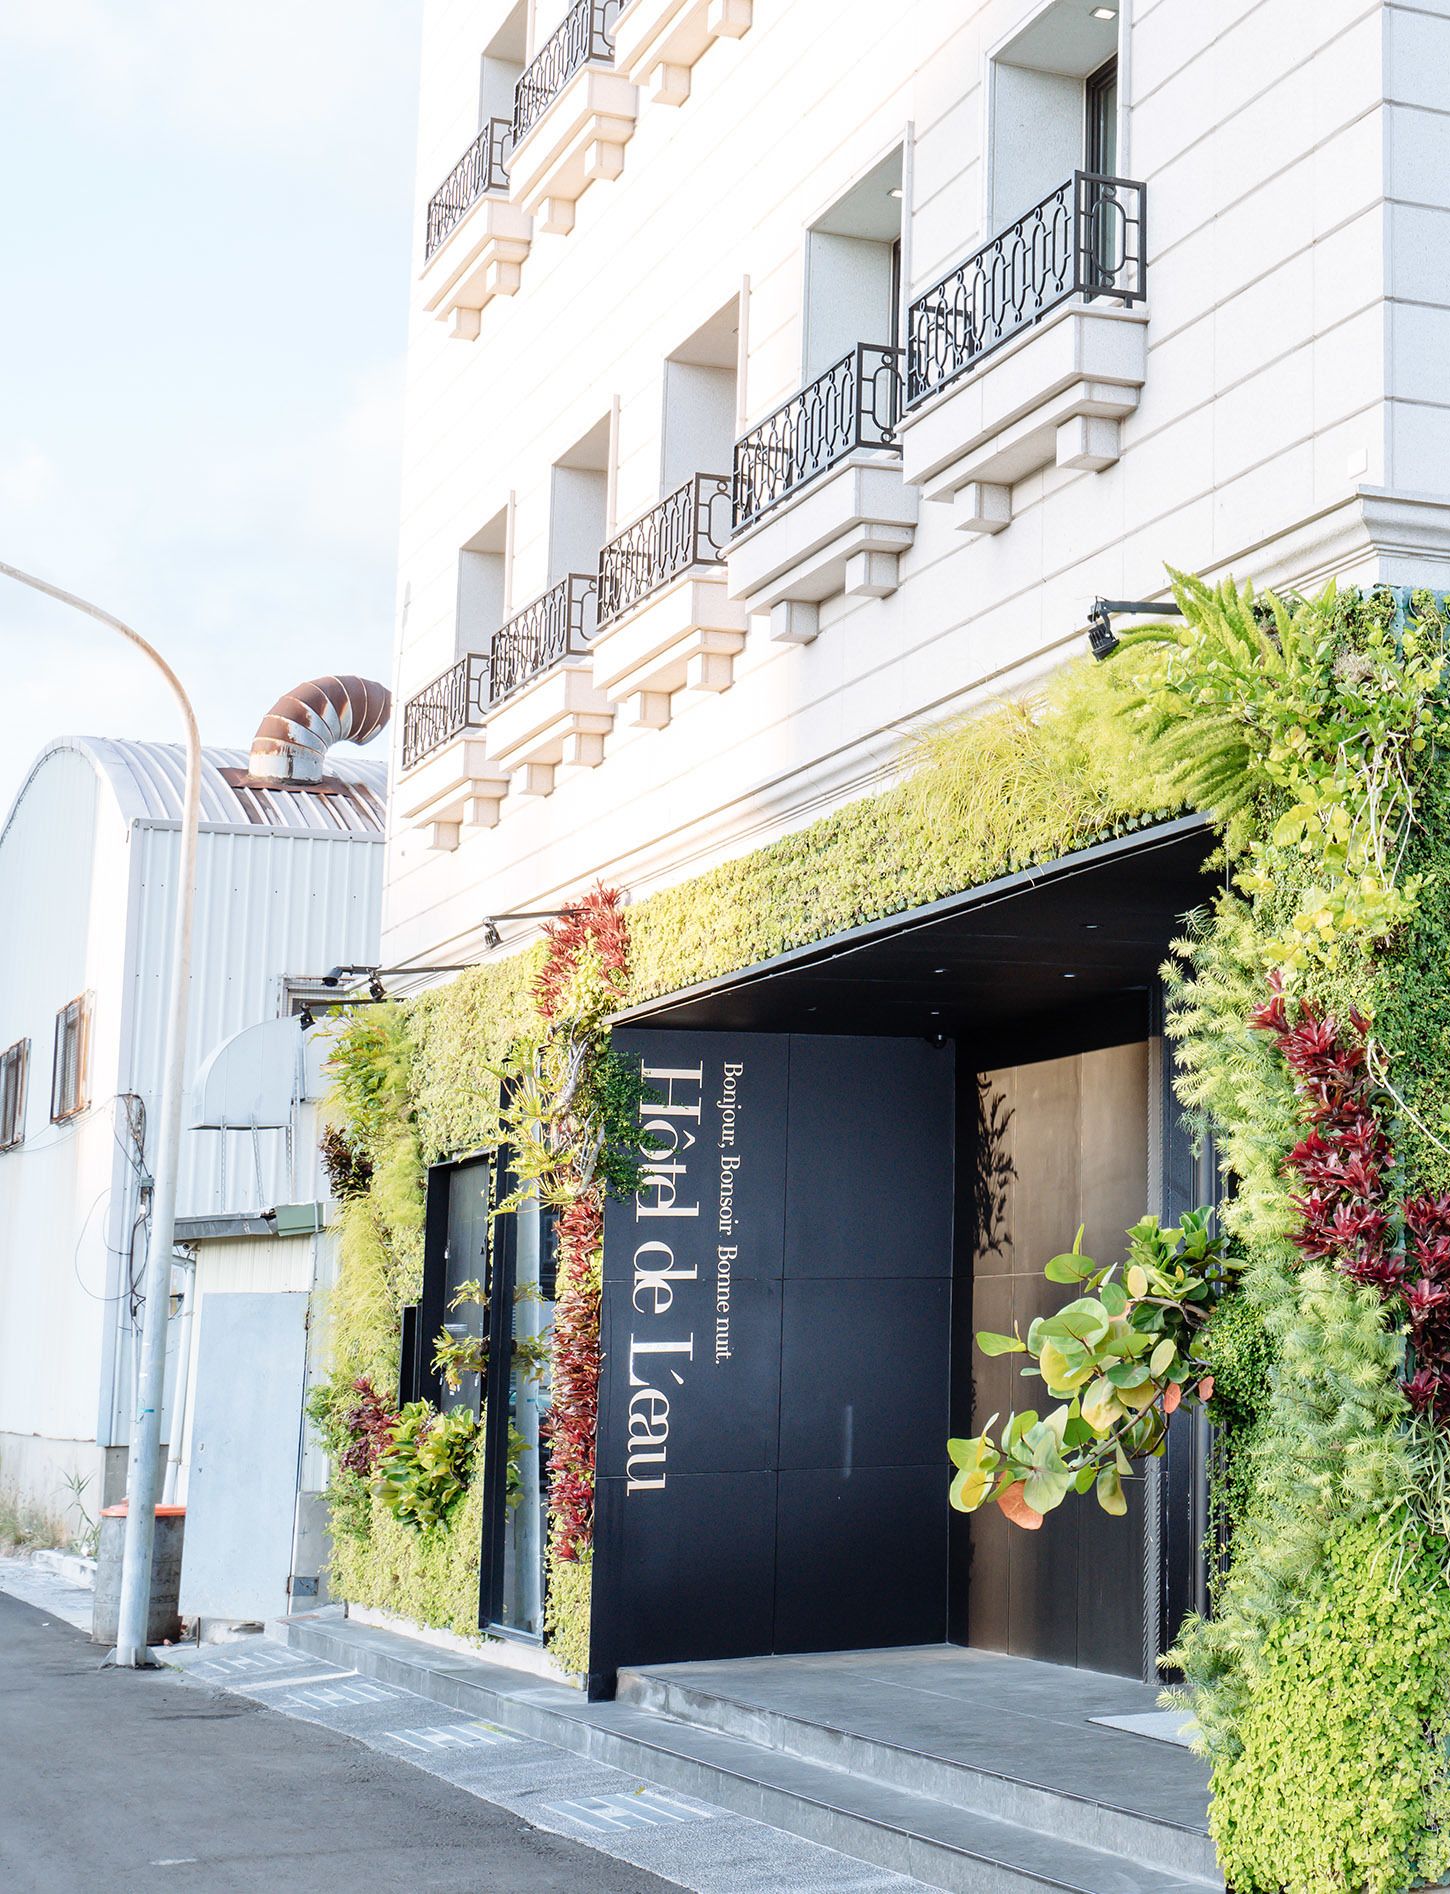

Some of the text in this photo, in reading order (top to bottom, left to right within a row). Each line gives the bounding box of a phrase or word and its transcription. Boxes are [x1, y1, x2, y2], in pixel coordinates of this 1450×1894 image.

[626, 1058, 704, 1497] Hôtel de L'eau
[715, 1061, 744, 1365] Bonjour, Bonsoir Bonne nuit.
